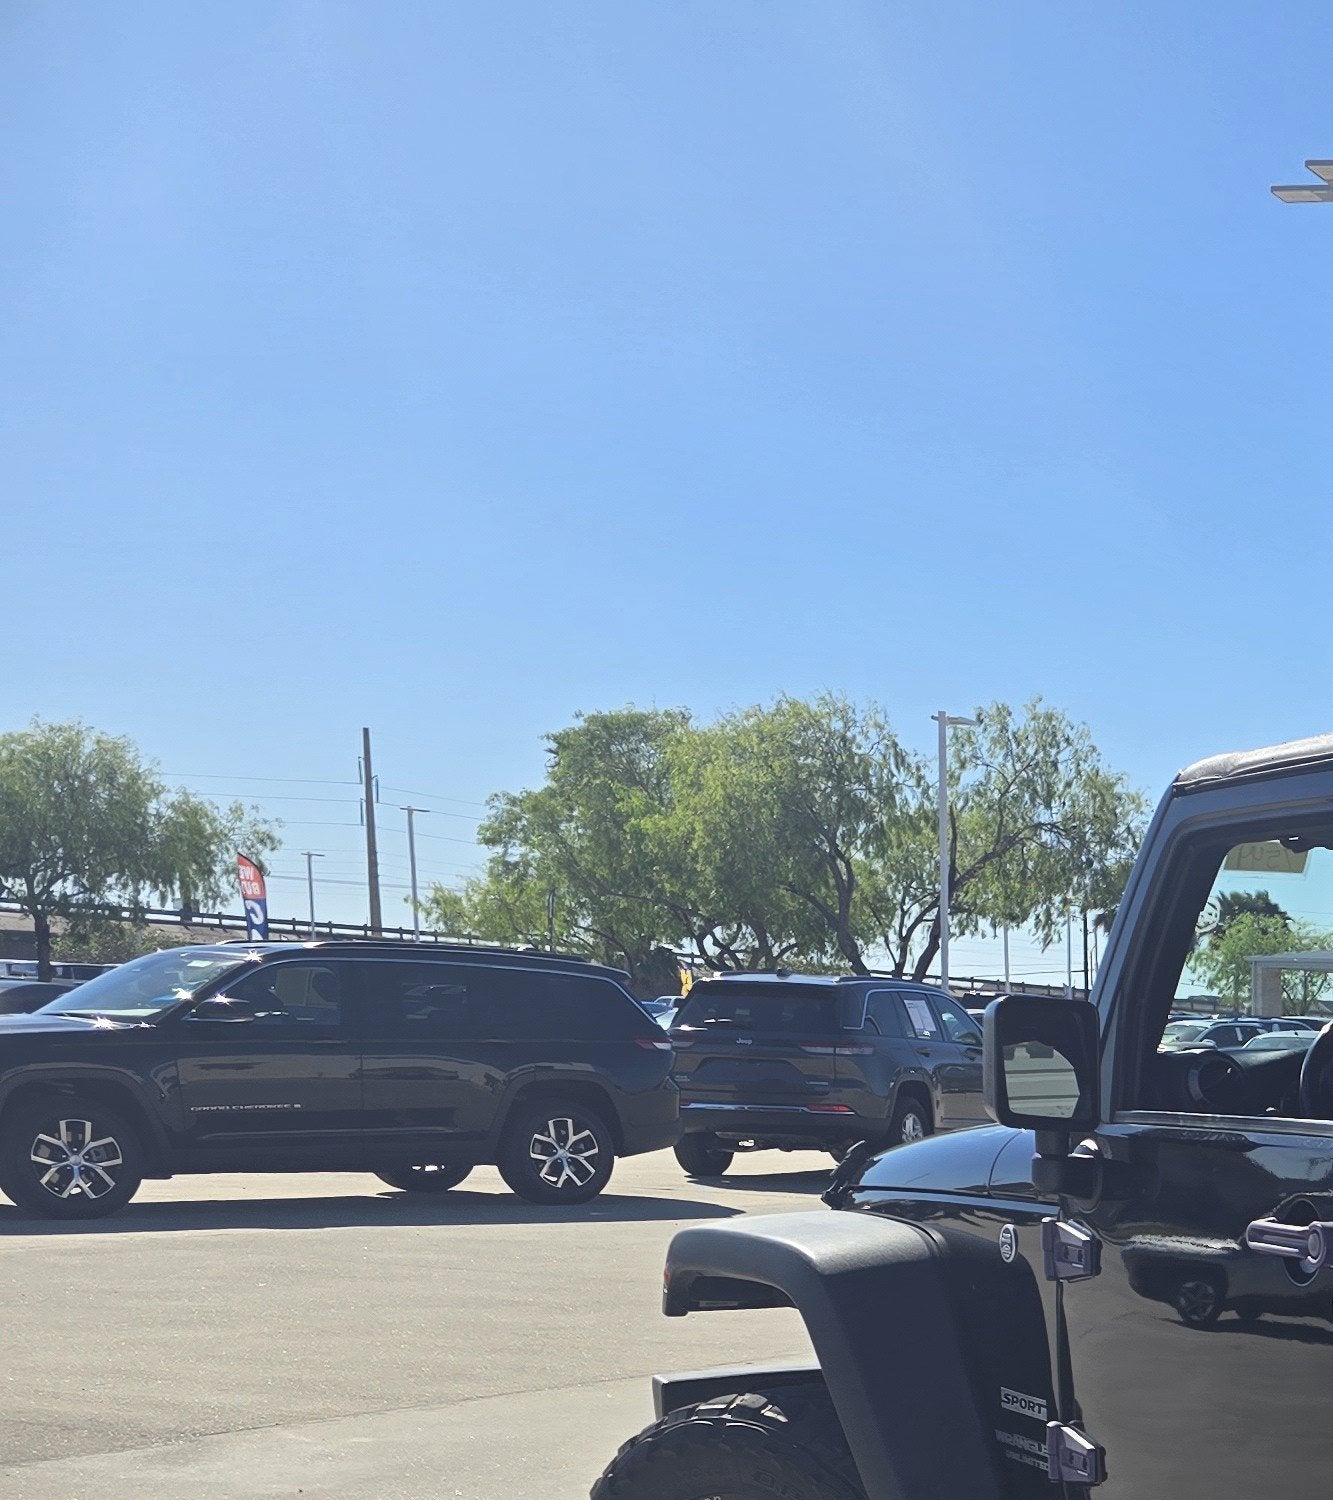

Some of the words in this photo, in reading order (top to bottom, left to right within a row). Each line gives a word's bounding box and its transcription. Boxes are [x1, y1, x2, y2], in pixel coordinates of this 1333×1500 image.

[736, 1037, 753, 1045] Jeep
[1001, 1392, 1048, 1415] SPORT
[995, 1429, 1049, 1457] WRANGLE
